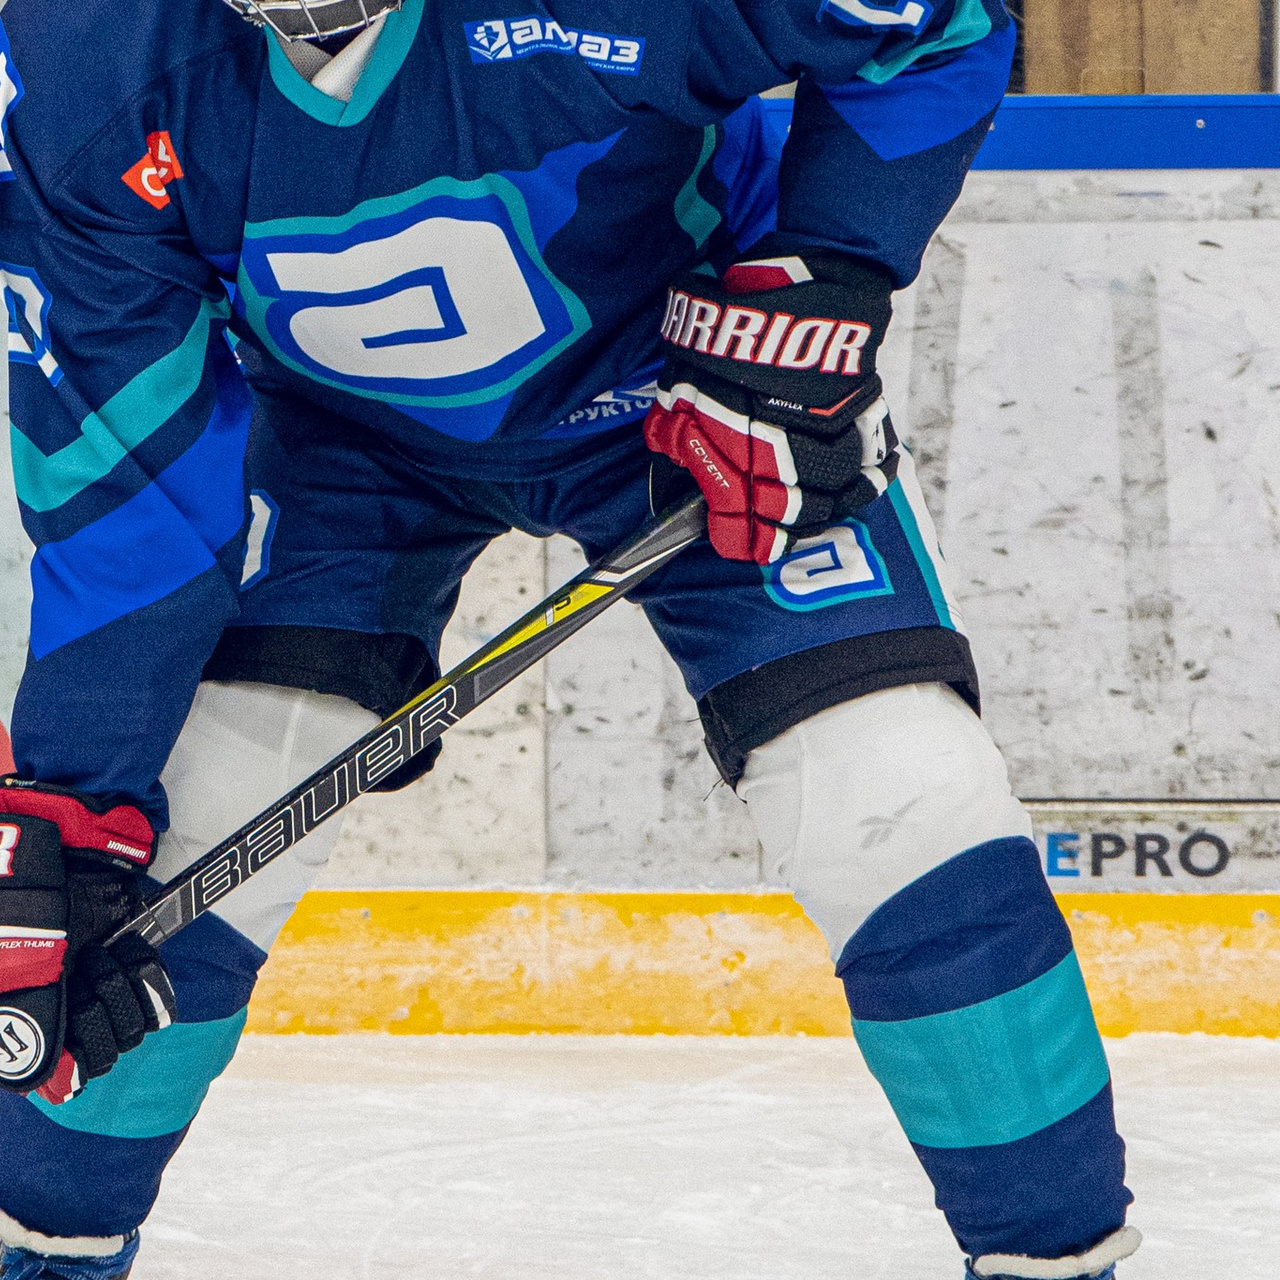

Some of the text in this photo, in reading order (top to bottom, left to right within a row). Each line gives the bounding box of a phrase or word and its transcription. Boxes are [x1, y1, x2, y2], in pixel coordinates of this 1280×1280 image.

[768, 398, 804, 411] AXYFLEX
[689, 438, 730, 489] COVERT
[1046, 831, 1232, 878] EPRO
[23, 939, 55, 949] THUMB
